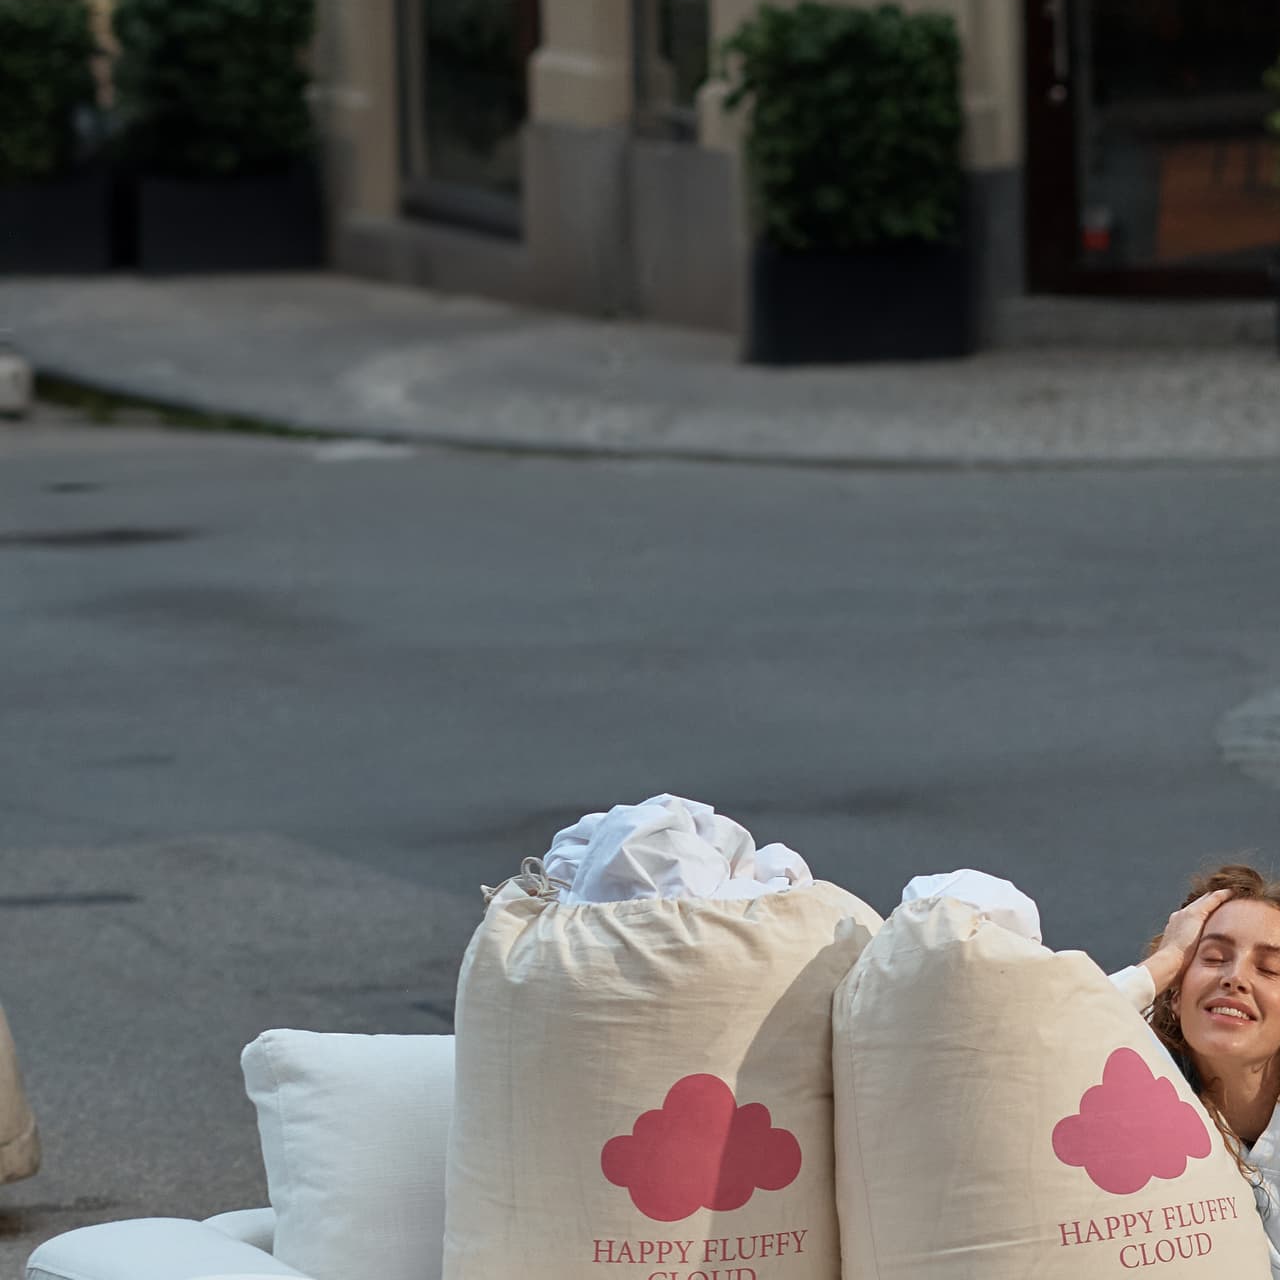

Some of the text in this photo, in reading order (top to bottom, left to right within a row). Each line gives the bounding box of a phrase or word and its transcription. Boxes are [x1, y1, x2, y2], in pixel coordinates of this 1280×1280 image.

[1058, 1196, 1239, 1247] HAPPY FLUFFY
[592, 1229, 808, 1264] HAPPY FLUFFY
[1119, 1231, 1213, 1269] CLOUD
